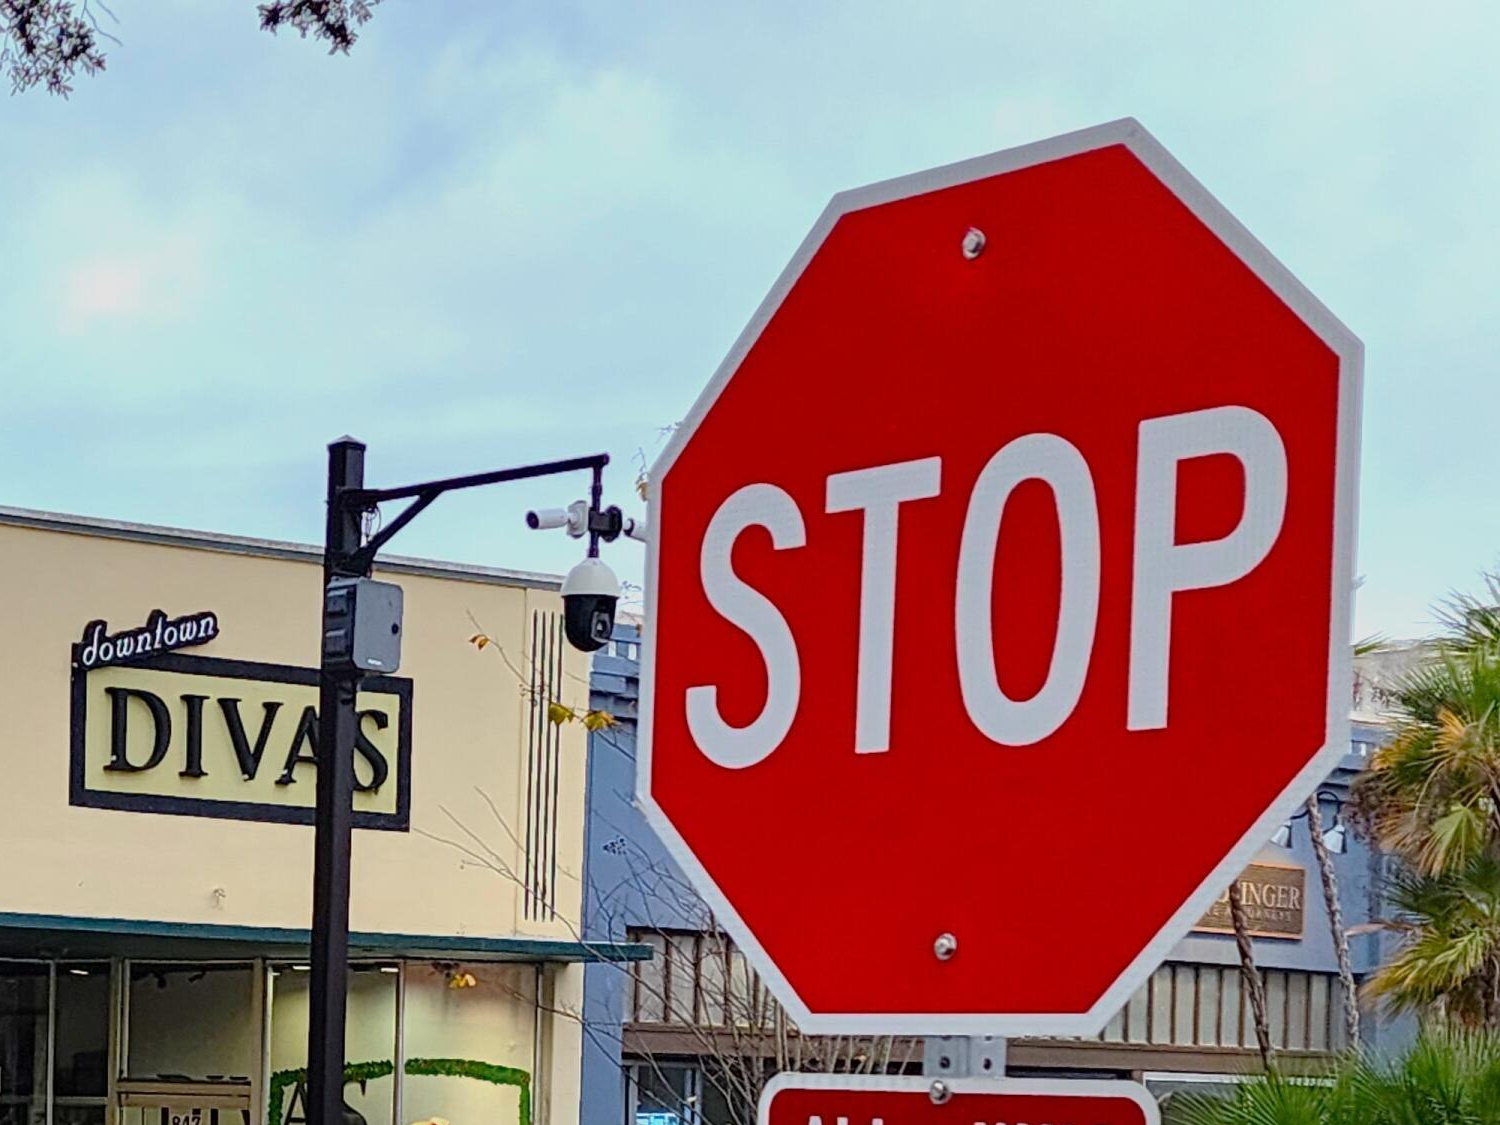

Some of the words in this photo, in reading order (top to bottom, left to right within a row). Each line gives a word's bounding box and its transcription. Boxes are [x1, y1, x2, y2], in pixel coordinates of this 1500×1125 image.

[686, 405, 1288, 769] STOP
[82, 616, 214, 666] downtown
[103, 686, 389, 793] DIVAS
